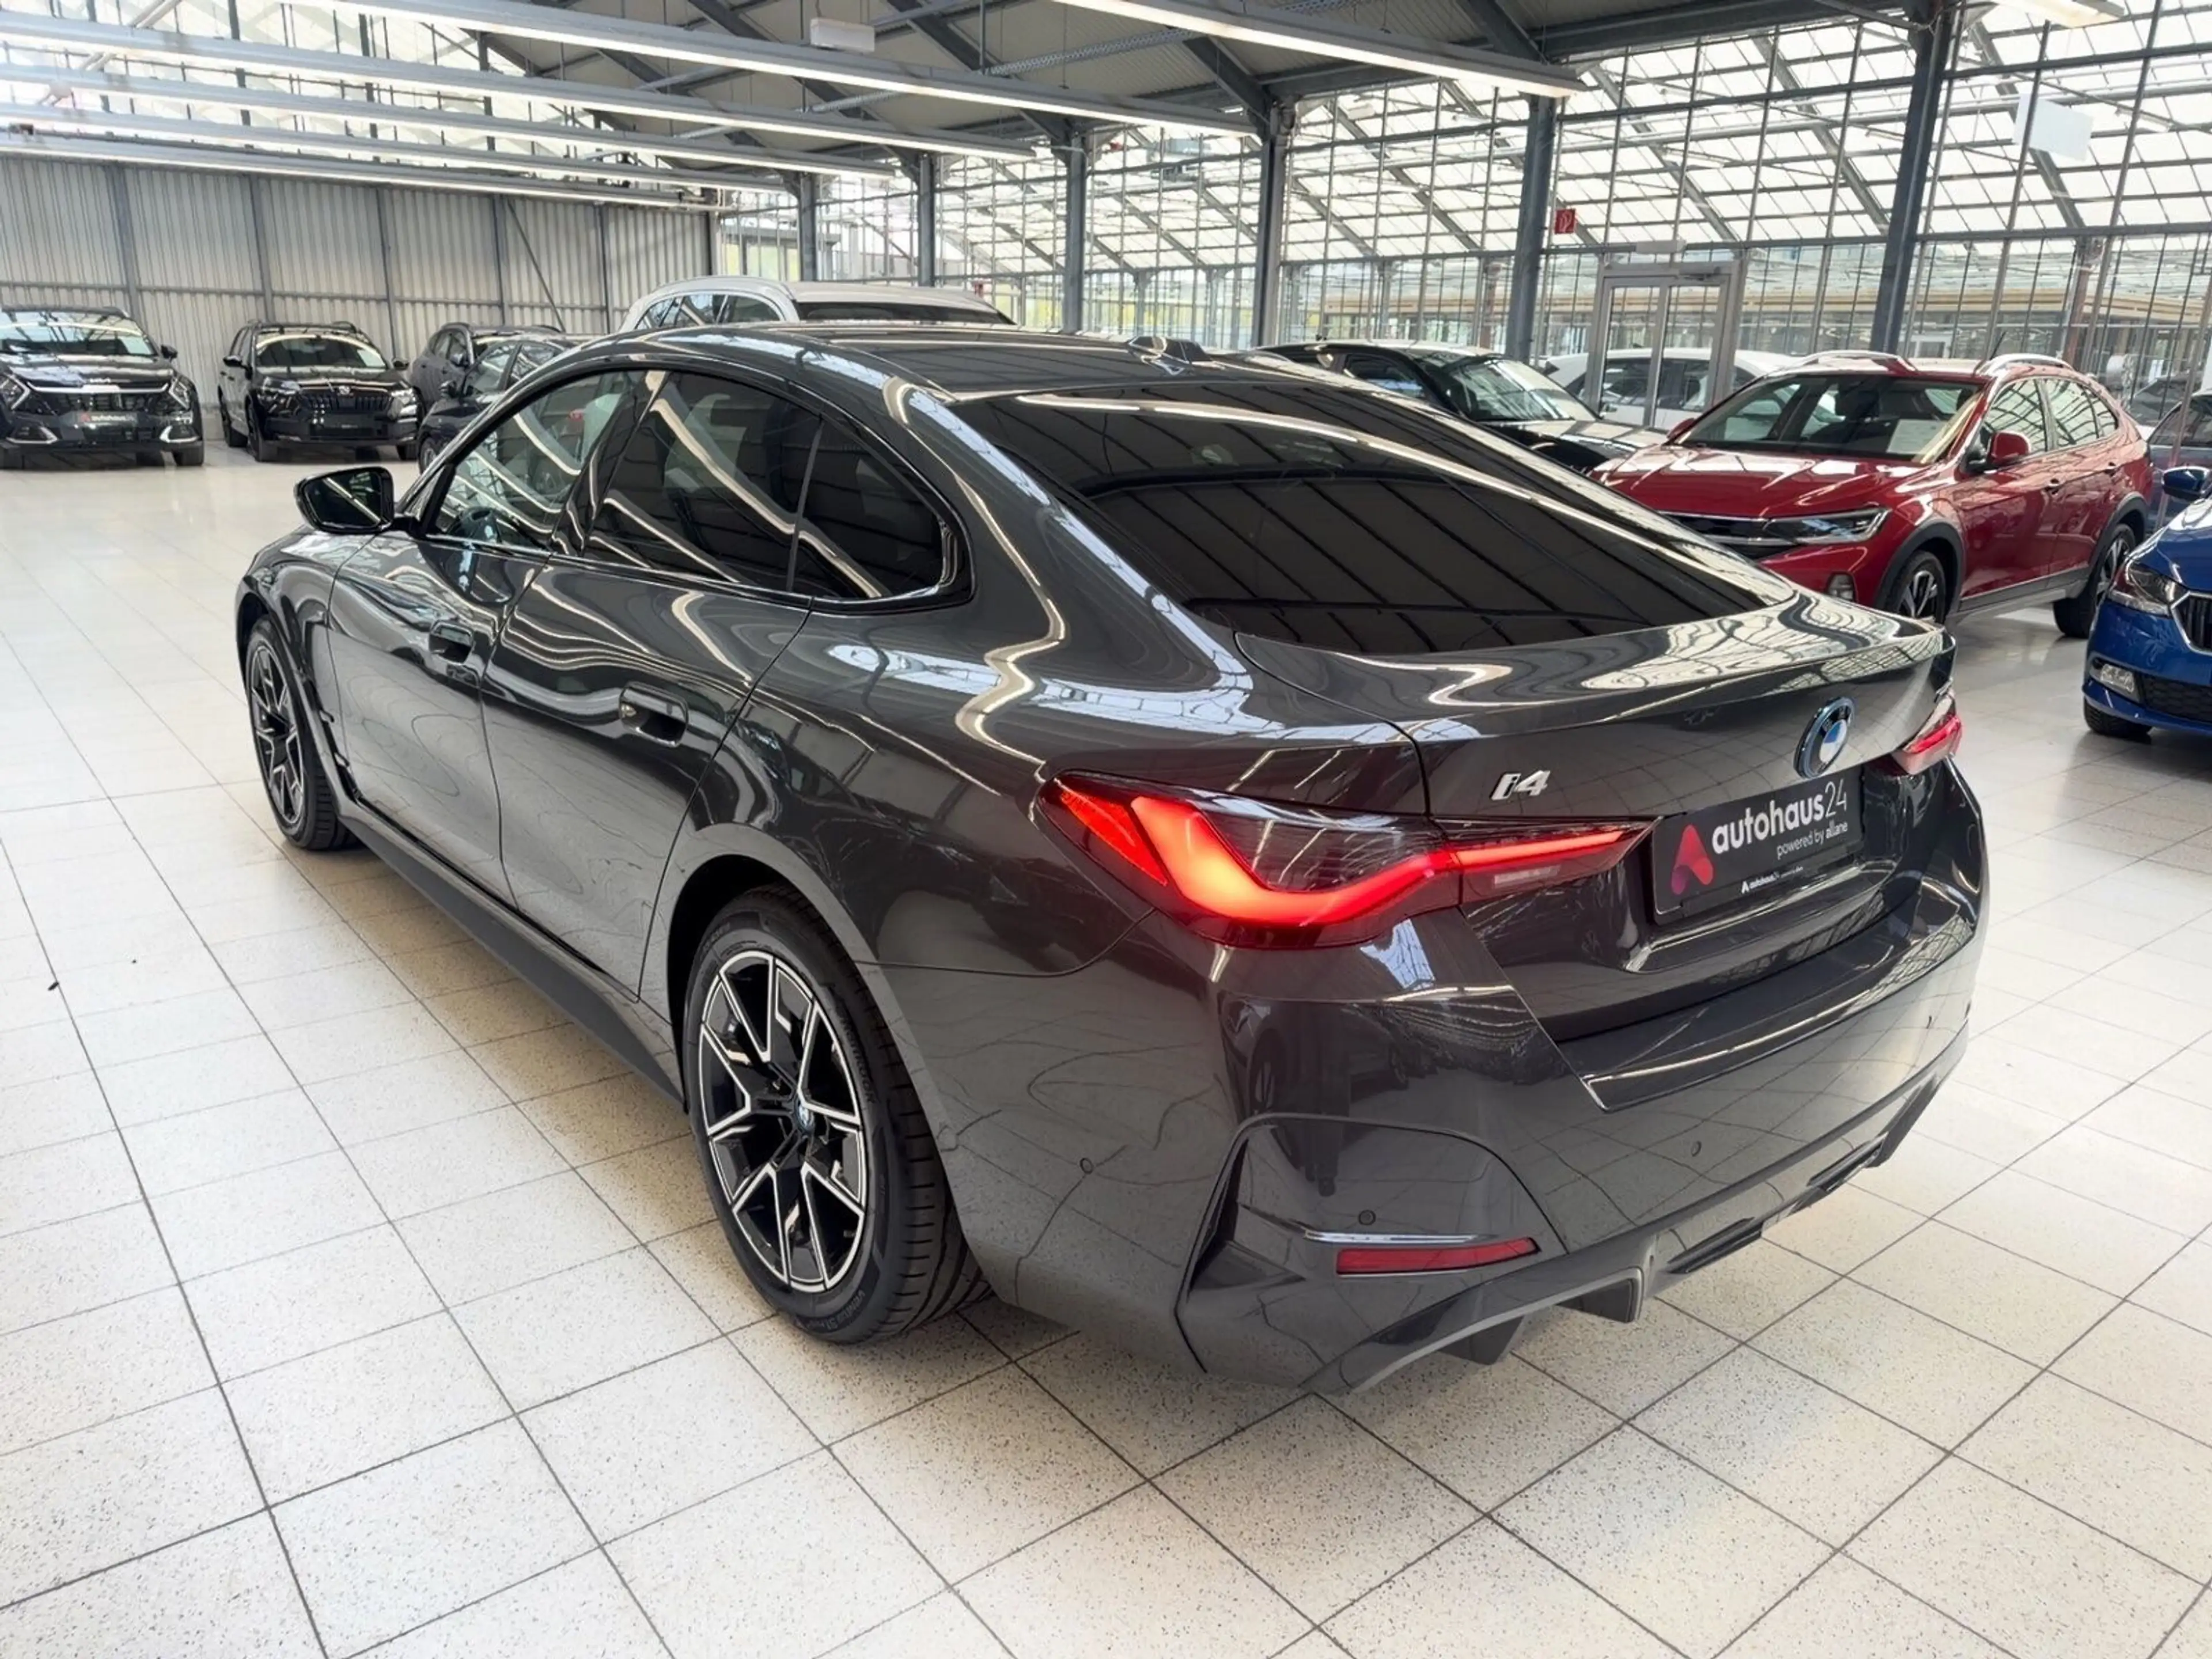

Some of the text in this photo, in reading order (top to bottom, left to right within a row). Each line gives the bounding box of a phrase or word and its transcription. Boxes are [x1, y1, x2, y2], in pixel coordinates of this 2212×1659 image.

[1490, 770, 1551, 801] i4
[1711, 779, 1847, 854] autohaus24
[1777, 829, 1813, 860] powered
[1815, 827, 1824, 845] by
